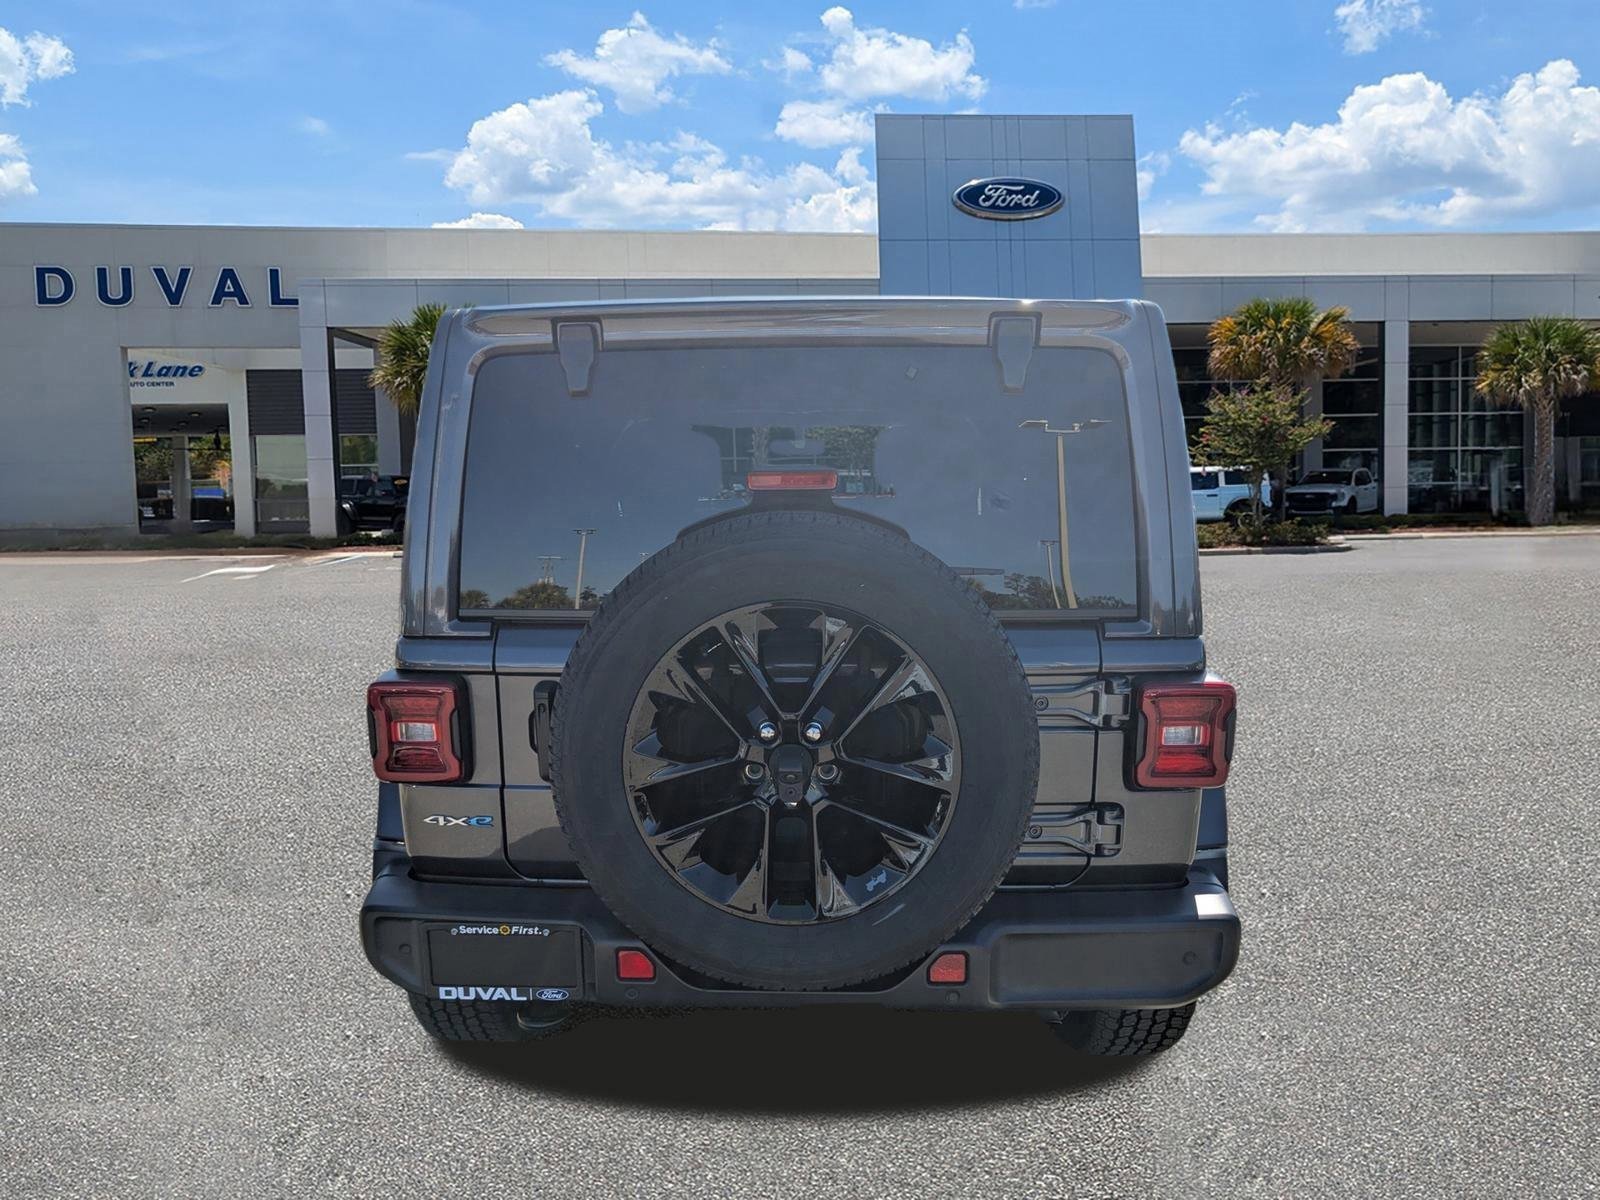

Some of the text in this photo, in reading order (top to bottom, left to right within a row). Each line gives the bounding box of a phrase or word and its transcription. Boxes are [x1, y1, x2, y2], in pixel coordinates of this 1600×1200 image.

[979, 184, 1040, 207] Ford
[34, 265, 299, 307] DUVAL
[142, 361, 204, 378] Lane
[459, 925, 542, 935] Service First.
[439, 987, 527, 1000] DUVAL
